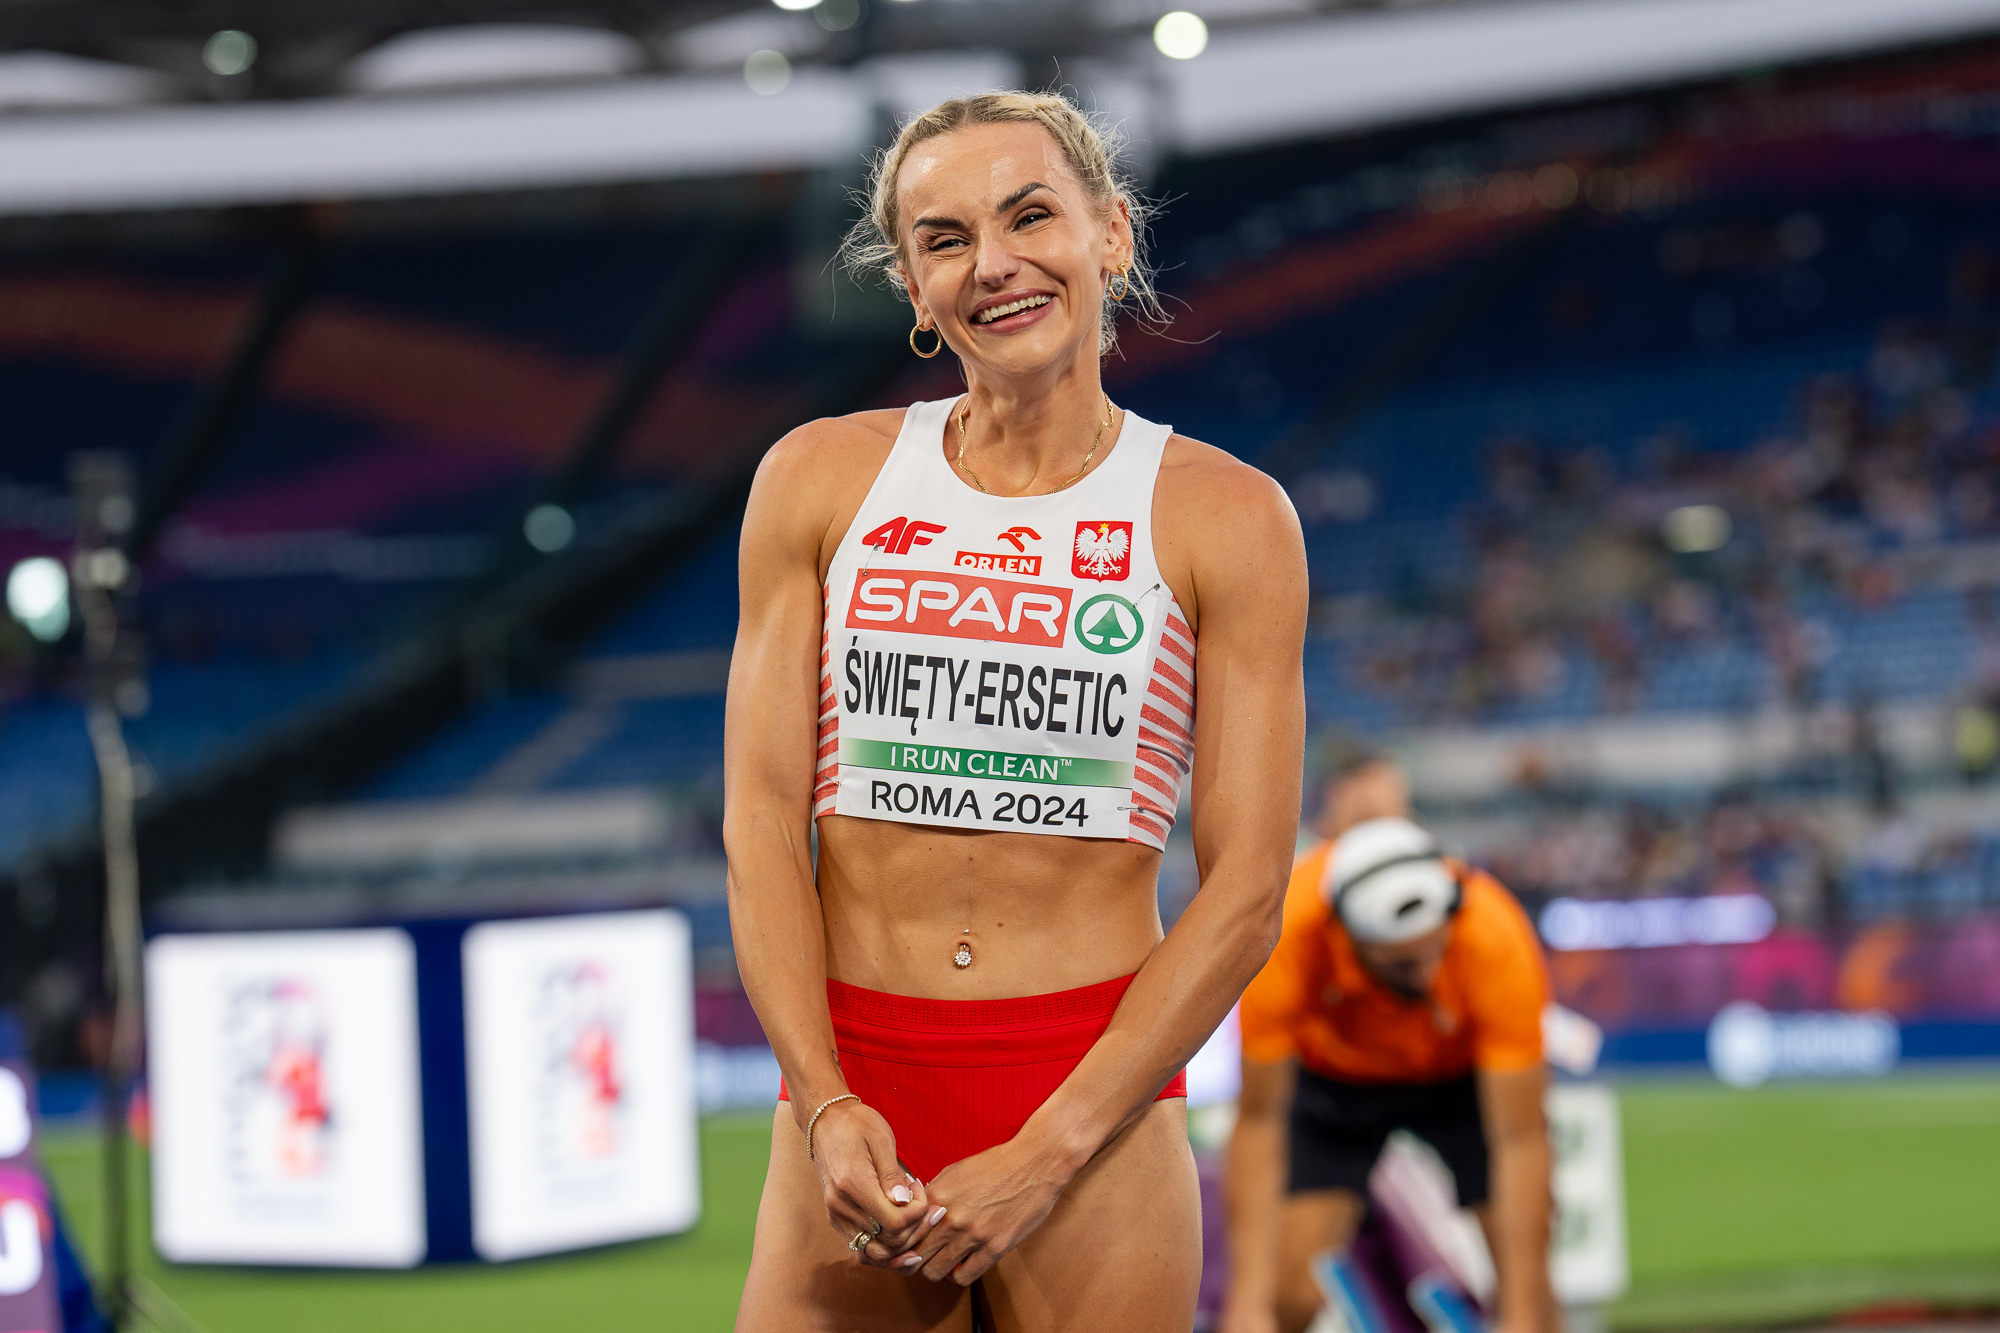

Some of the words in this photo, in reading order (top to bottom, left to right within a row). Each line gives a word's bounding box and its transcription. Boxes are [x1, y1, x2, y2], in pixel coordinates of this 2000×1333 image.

[862, 516, 947, 555] 4F
[959, 554, 1036, 574] ORLEN
[855, 577, 1063, 638] SPAR
[844, 636, 1127, 738] ŚWIĘTY-ERSETIC
[891, 746, 897, 766] I
[903, 747, 960, 772] RUN
[871, 780, 982, 820] ROMA
[992, 792, 1089, 827] 2024
